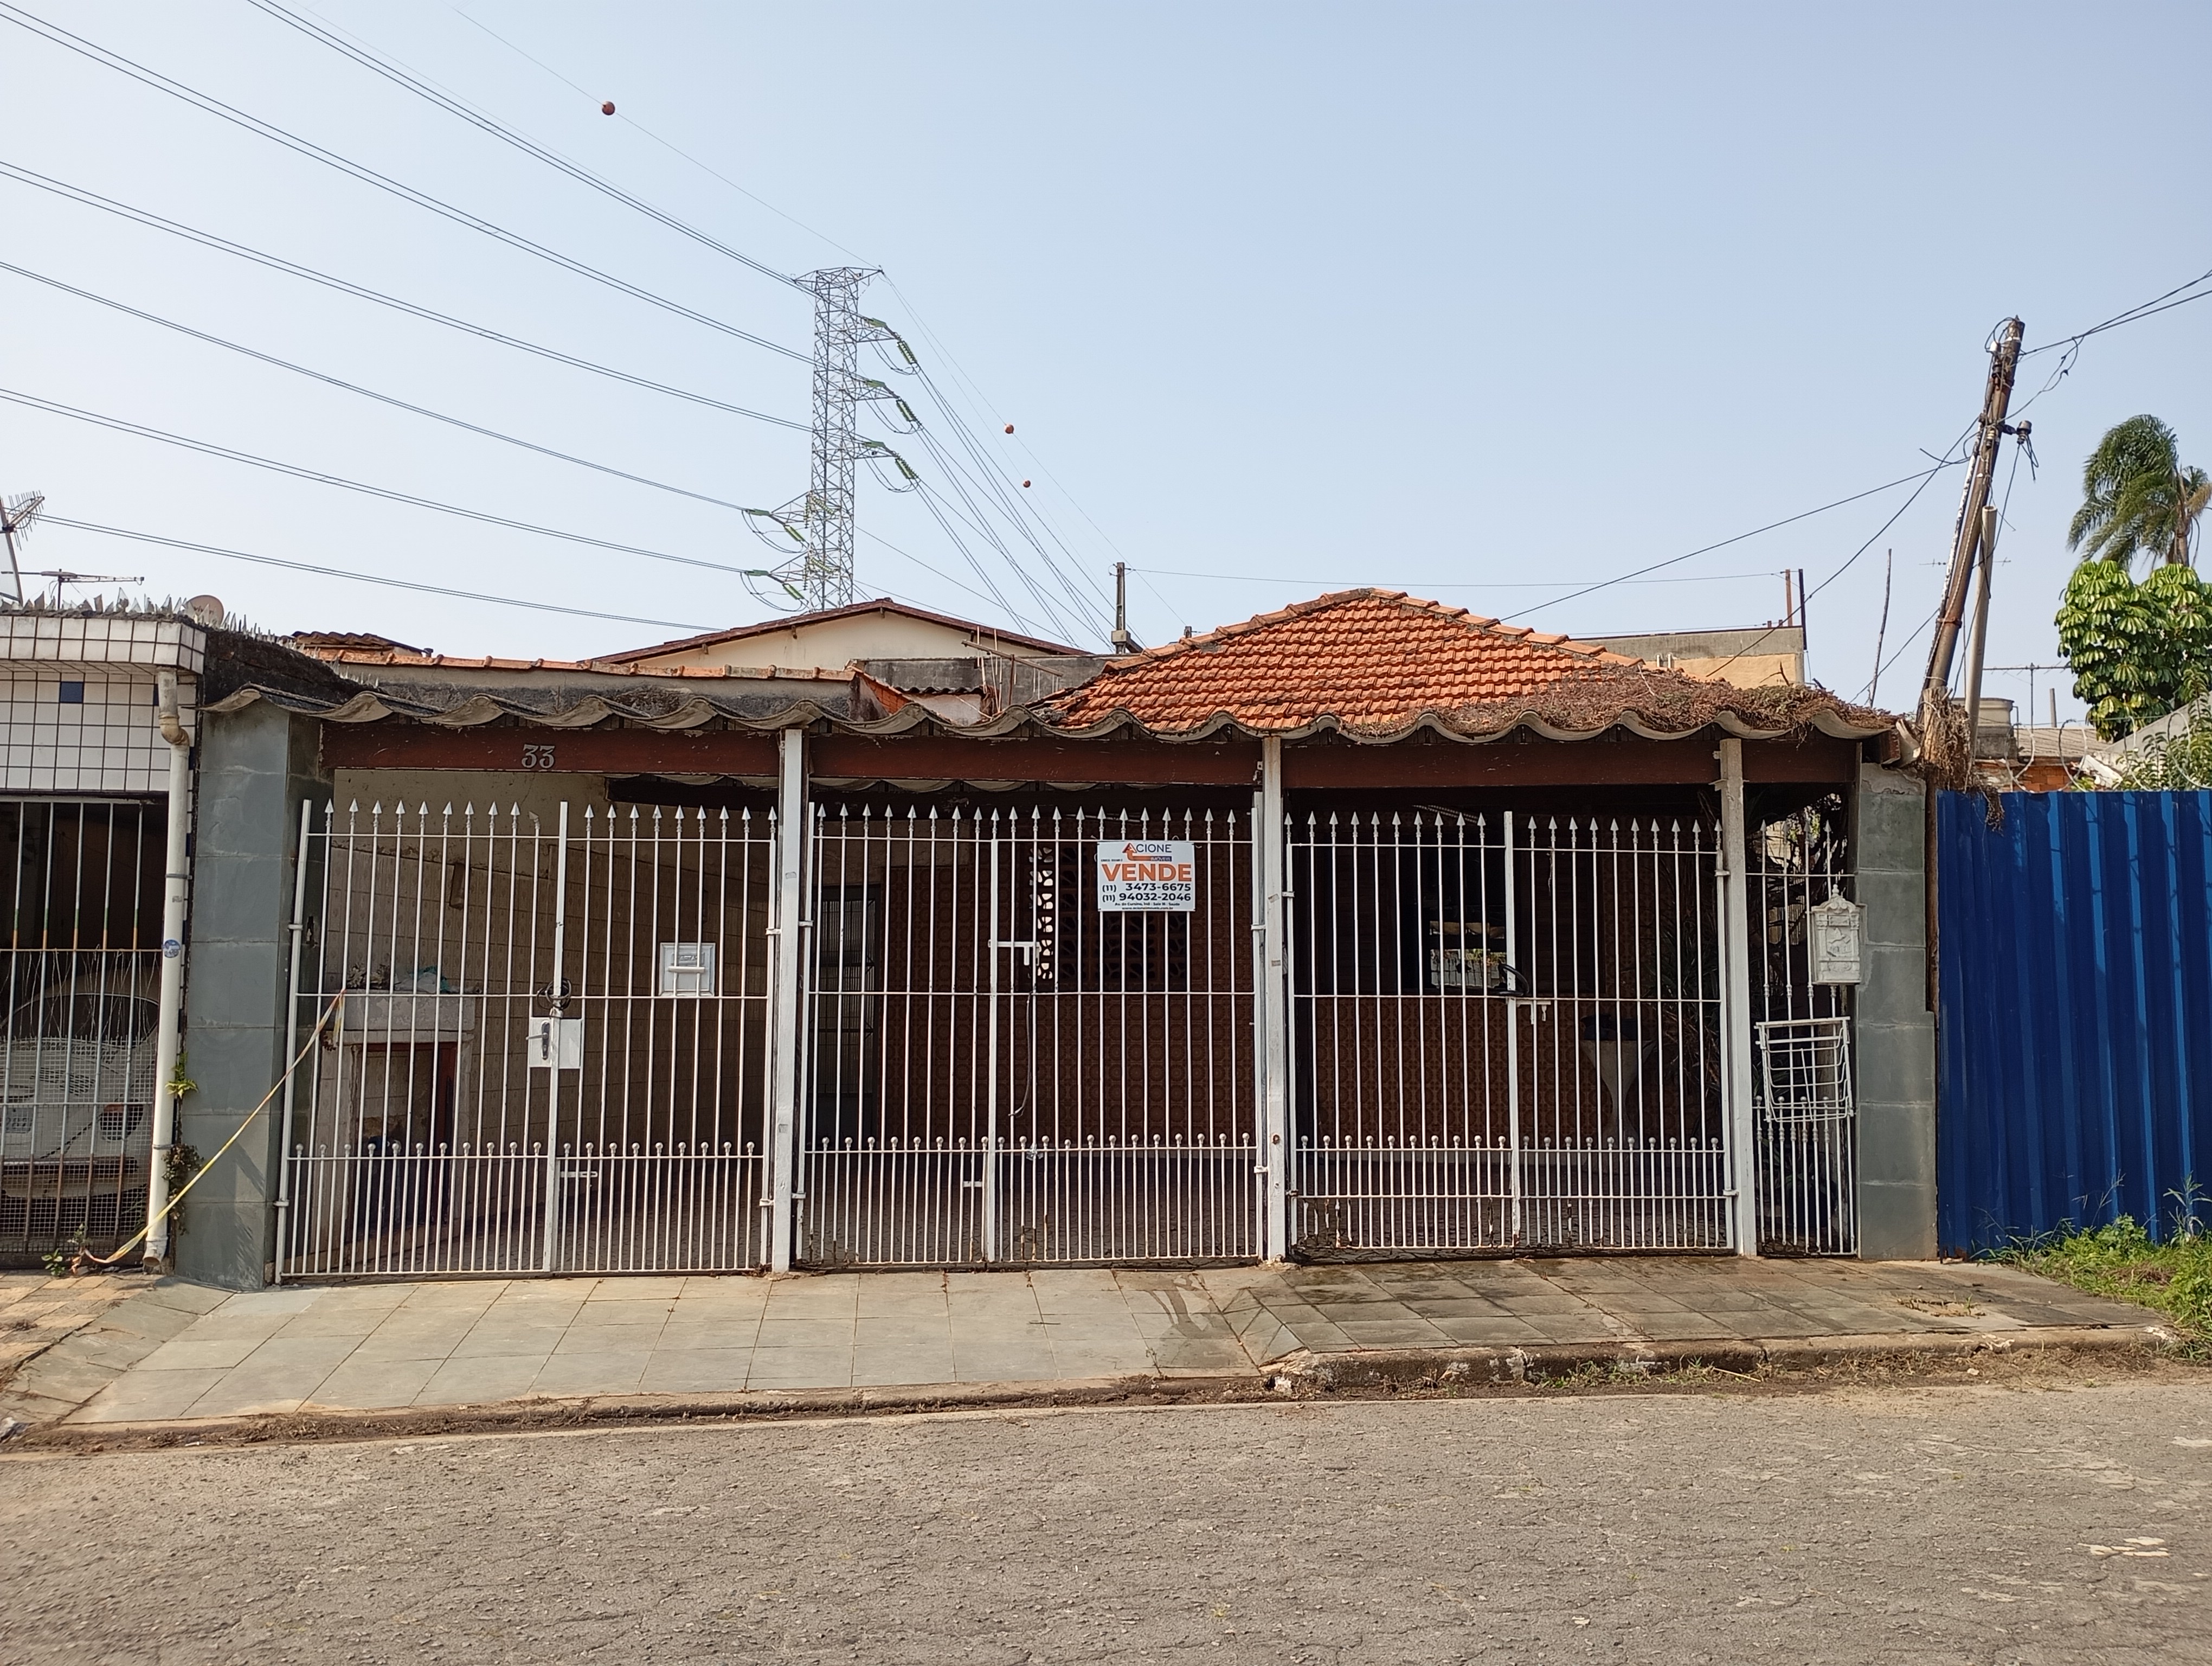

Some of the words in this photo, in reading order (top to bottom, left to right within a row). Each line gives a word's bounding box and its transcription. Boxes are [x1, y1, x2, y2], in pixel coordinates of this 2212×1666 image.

[522, 744, 555, 768] 33
[1122, 843, 1172, 853] ACIONE
[1102, 863, 1192, 881] VENDE
[1102, 885, 1116, 893] (11)
[1126, 883, 1191, 891] 3473-6675
[1119, 893, 1191, 901] 94032-2046
